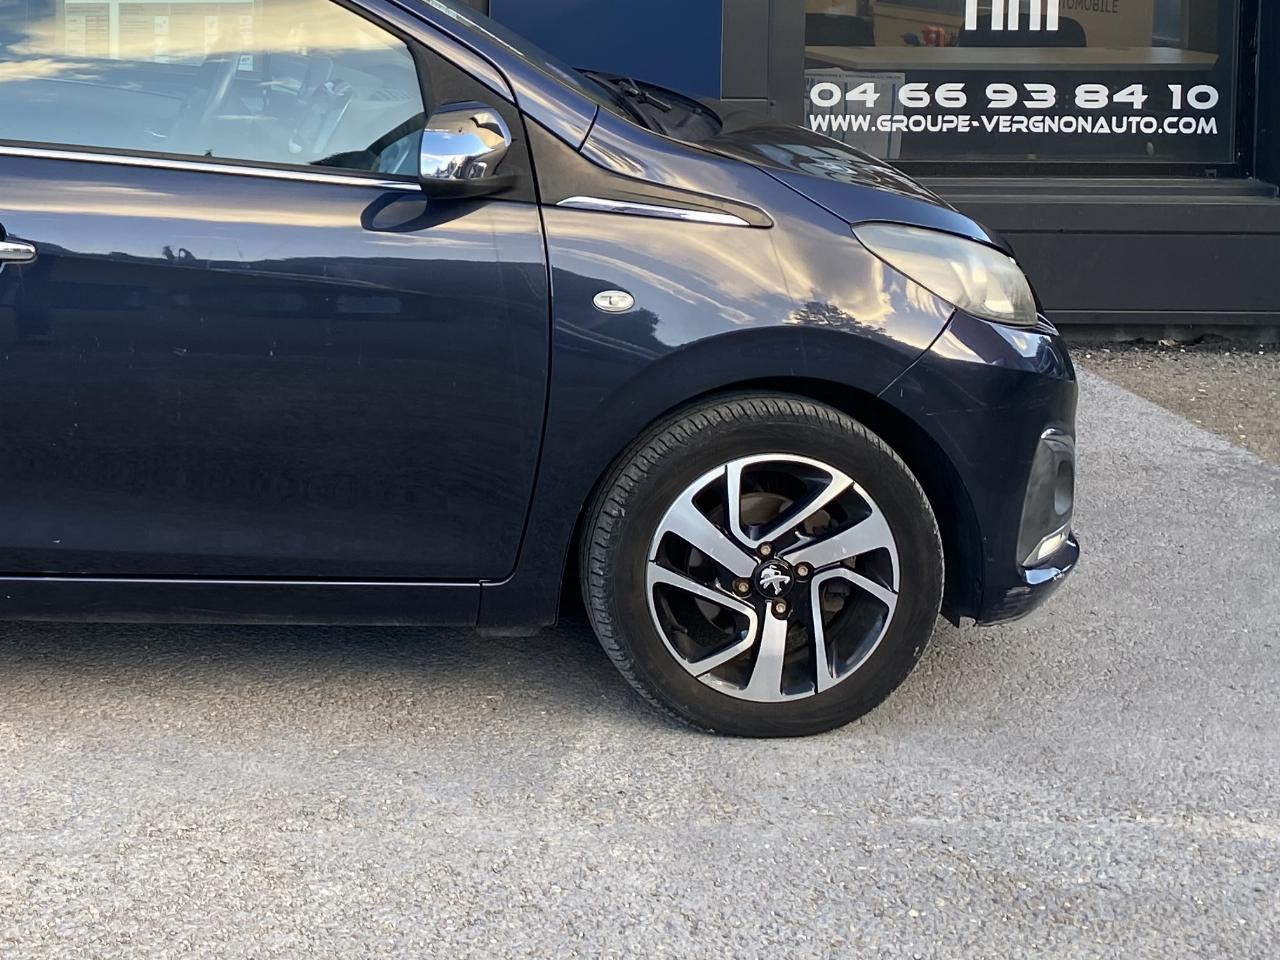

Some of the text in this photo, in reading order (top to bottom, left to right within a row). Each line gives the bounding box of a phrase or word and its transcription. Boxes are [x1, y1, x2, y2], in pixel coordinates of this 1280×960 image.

[809, 82, 1219, 109] 04 66 93 84 10
[809, 114, 1218, 135] WWW.GROUPE-VERGNONAUTO.COM
